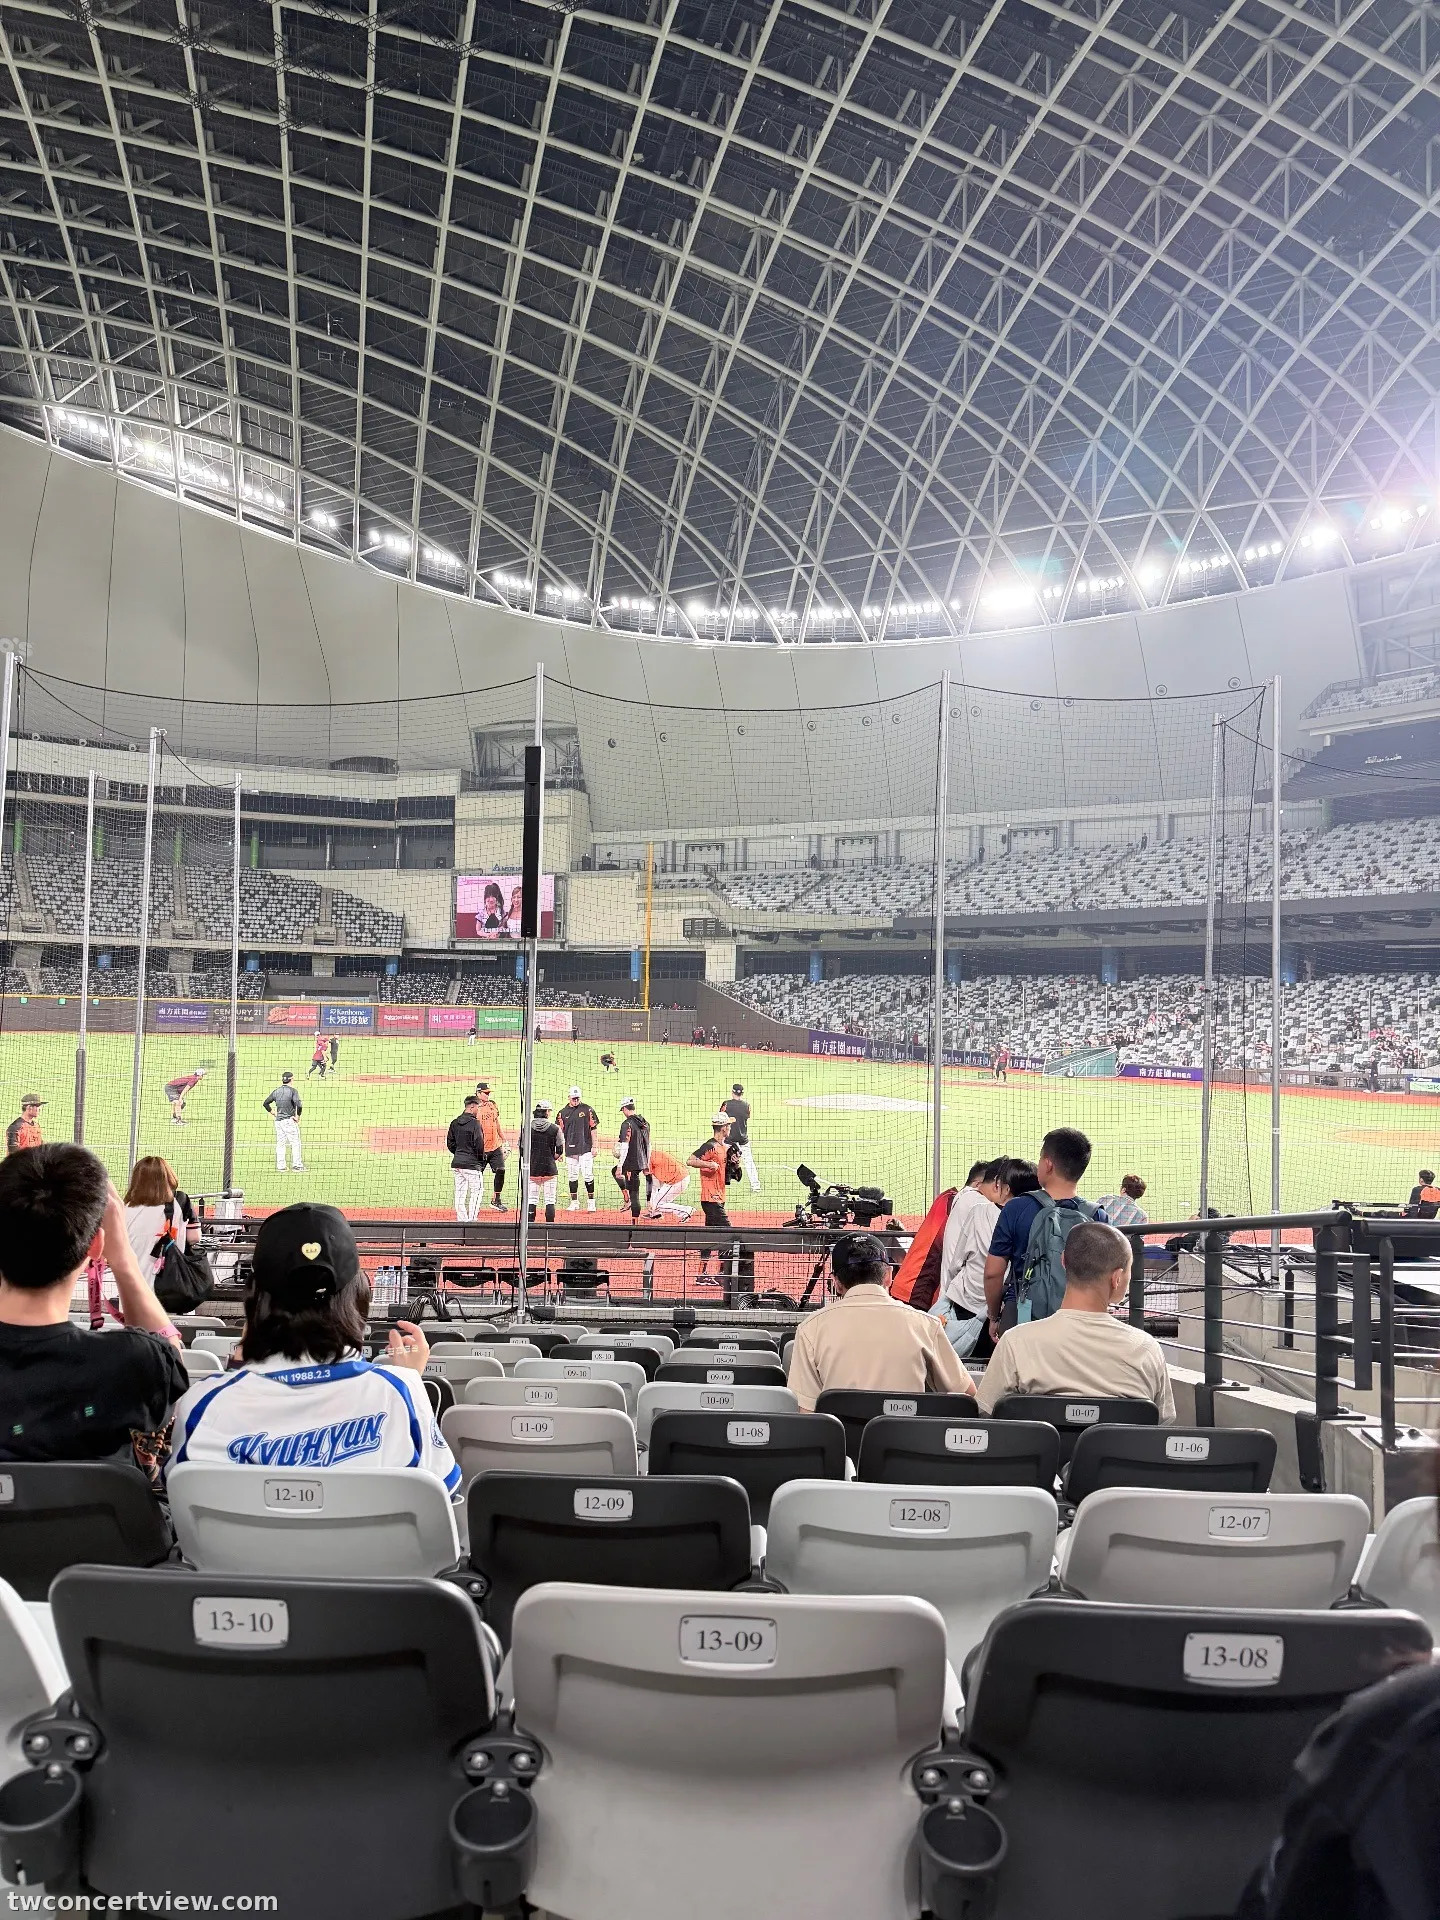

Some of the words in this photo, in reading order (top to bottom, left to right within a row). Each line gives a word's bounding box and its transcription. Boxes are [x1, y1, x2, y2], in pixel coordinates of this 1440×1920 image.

[594, 1352, 612, 1360] 08-10
[290, 1369, 331, 1382] 1988.2.3
[567, 1370, 587, 1378] 09-10
[710, 1373, 731, 1381] 09-09
[530, 1390, 553, 1400] 10-10
[706, 1396, 730, 1405] 10-09
[890, 1403, 913, 1412] 10-08
[1071, 1408, 1095, 1418] 10-07
[519, 1422, 548, 1433] 11-09
[734, 1427, 764, 1438] 11-08
[952, 1434, 982, 1445] 11-07
[1173, 1442, 1203, 1453] 11-06
[274, 1488, 315, 1502] 12-10
[584, 1496, 625, 1510] 12-09
[900, 1508, 941, 1522] 12-08
[1218, 1515, 1261, 1530] 12-07
[209, 1610, 274, 1633] 13-10
[696, 1630, 763, 1652] 13-09
[1200, 1646, 1268, 1669] 13-08
